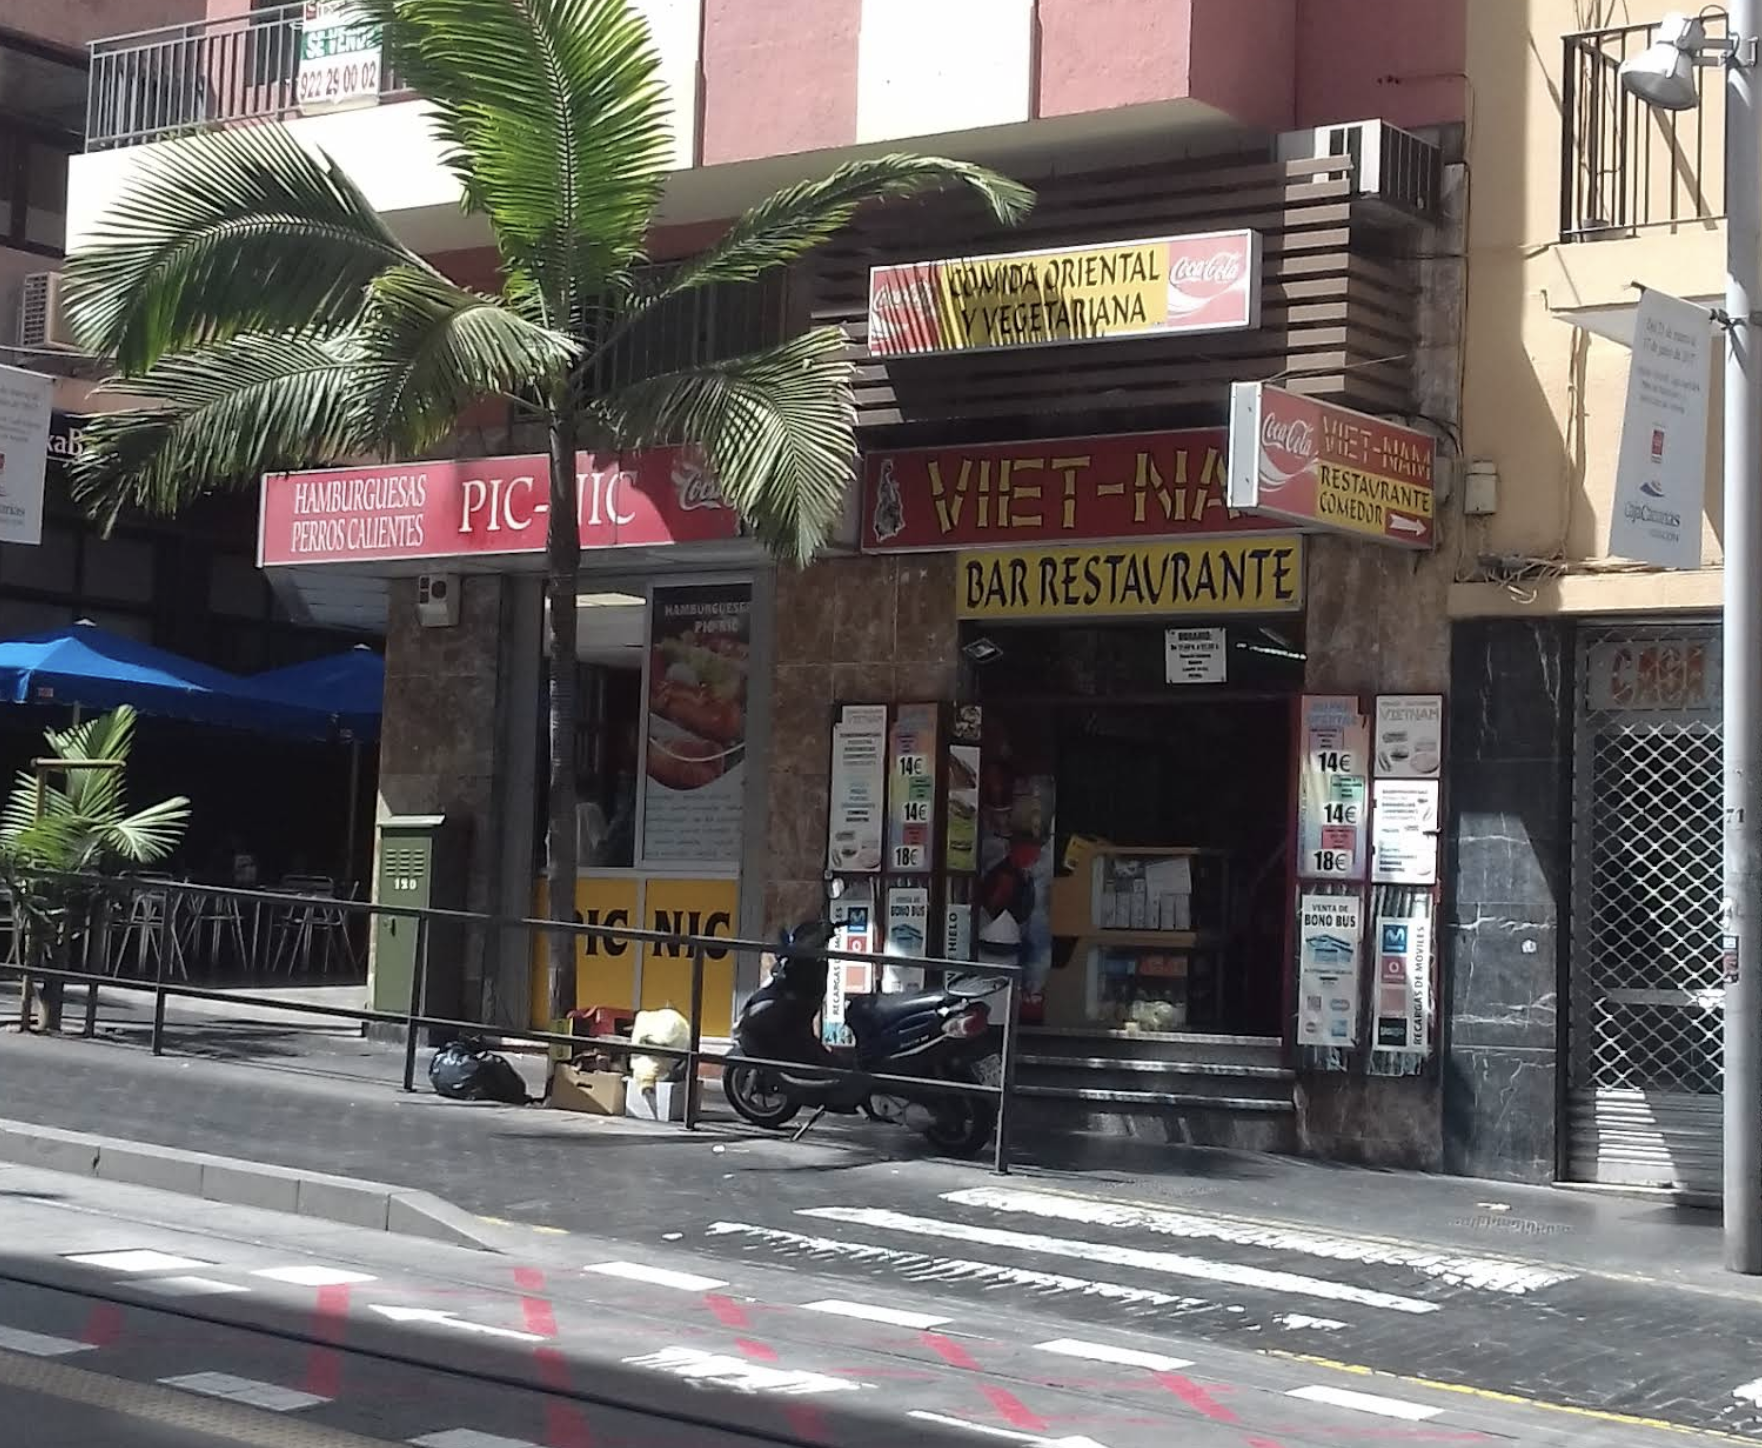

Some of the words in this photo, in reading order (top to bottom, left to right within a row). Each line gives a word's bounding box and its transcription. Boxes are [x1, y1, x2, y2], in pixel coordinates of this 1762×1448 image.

[305, 31, 327, 58] SE
[300, 71, 322, 100] 922
[326, 67, 340, 96] 29
[343, 64, 358, 93] 00
[362, 61, 377, 90] 02
[947, 263, 1037, 299] COMIDA
[1044, 249, 1160, 292] ORIENTAL
[961, 308, 979, 337] Y
[983, 294, 1147, 335] VEGETARIANA
[1323, 415, 1431, 481] VIET-NAM
[294, 474, 428, 515] HAMBURGUESAS
[927, 446, 1241, 534] VIET-NA
[1319, 491, 1383, 526] COMEDOR
[290, 519, 345, 554] PERROS
[346, 514, 425, 552] CALIENTES
[966, 557, 1030, 608] BAR
[900, 756, 923, 776] 14€
[1318, 752, 1352, 773] 14€
[904, 801, 927, 820] 14€
[1324, 803, 1357, 824] 14€
[1726, 808, 1745, 823] 71
[895, 847, 918, 866] 18€
[1313, 850, 1347, 871] 18€
[1304, 914, 1333, 929] BONO
[1336, 915, 1356, 930] BUS
[1312, 903, 1336, 912] VENTA
[1338, 904, 1349, 913] DE
[652, 909, 731, 960] NIC
[948, 912, 957, 951] HIELO
[832, 965, 842, 1016] RECARGAS
[1414, 974, 1424, 989] DE
[1413, 988, 1424, 1046] RECARGAS
